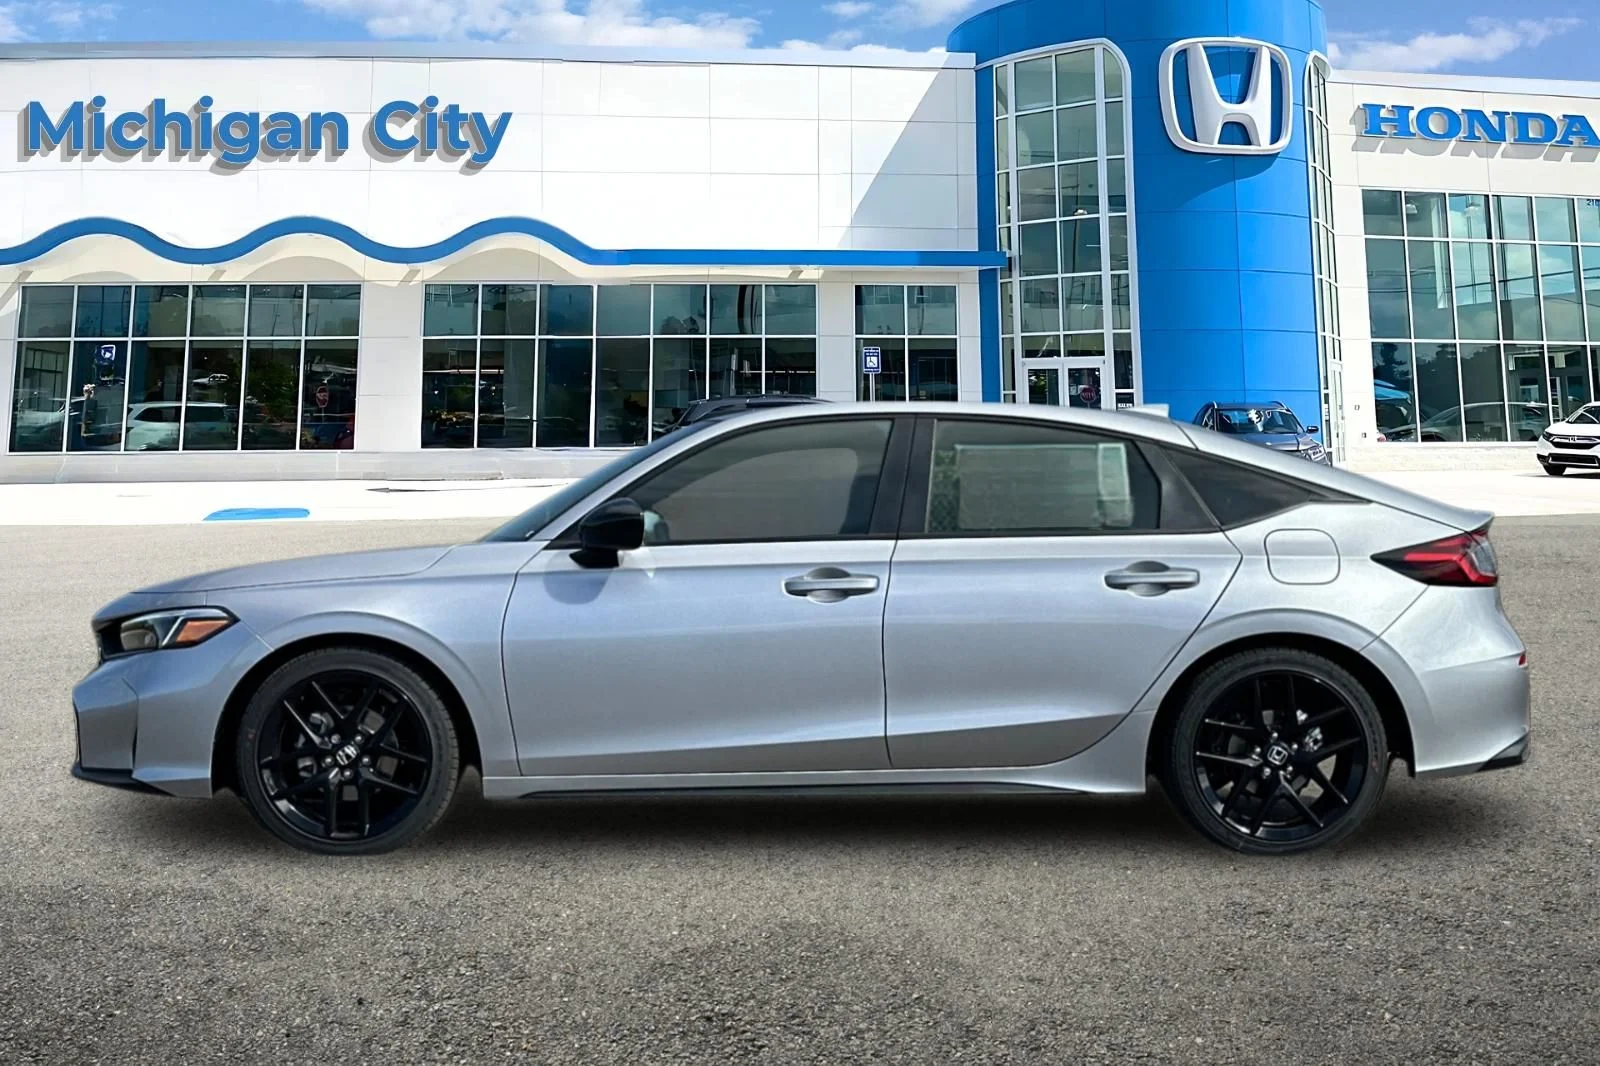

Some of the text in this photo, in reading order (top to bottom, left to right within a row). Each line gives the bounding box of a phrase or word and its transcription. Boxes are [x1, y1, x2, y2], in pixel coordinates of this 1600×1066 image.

[28, 95, 513, 164] Michigan City
[1362, 103, 1600, 147] HONDA
